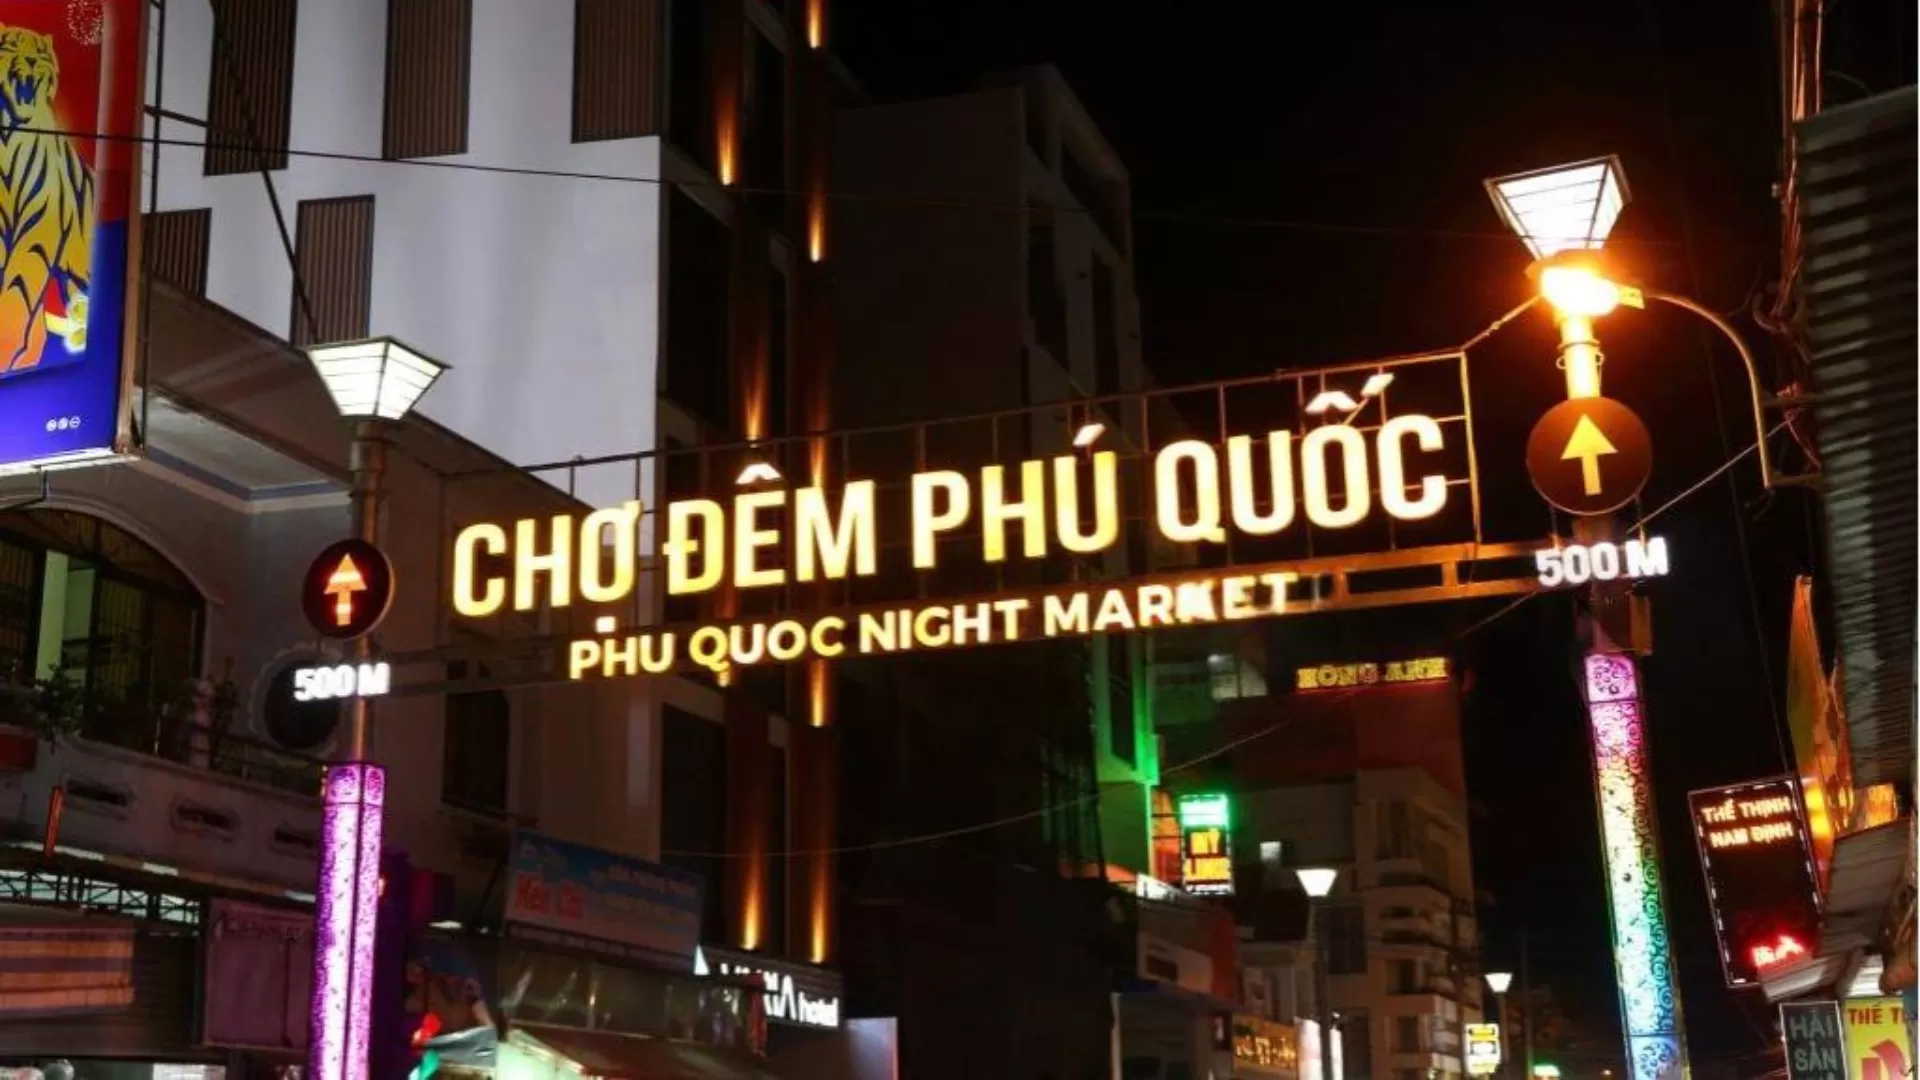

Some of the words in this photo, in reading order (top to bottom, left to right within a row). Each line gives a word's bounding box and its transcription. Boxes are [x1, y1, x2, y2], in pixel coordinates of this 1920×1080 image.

[453, 499, 643, 632] CHỢ
[663, 463, 877, 596] ĐÊM
[912, 423, 1118, 568] PHÚ
[1154, 373, 1448, 543] QUỐC
[1535, 541, 1619, 587] 500
[1625, 536, 1669, 577] M
[570, 632, 675, 680] PHU
[689, 616, 845, 672] QUOC
[860, 599, 1028, 653] NIGHT
[1044, 572, 1298, 636] MARKET
[294, 664, 357, 701] 500
[1710, 828, 1749, 848] NAM
